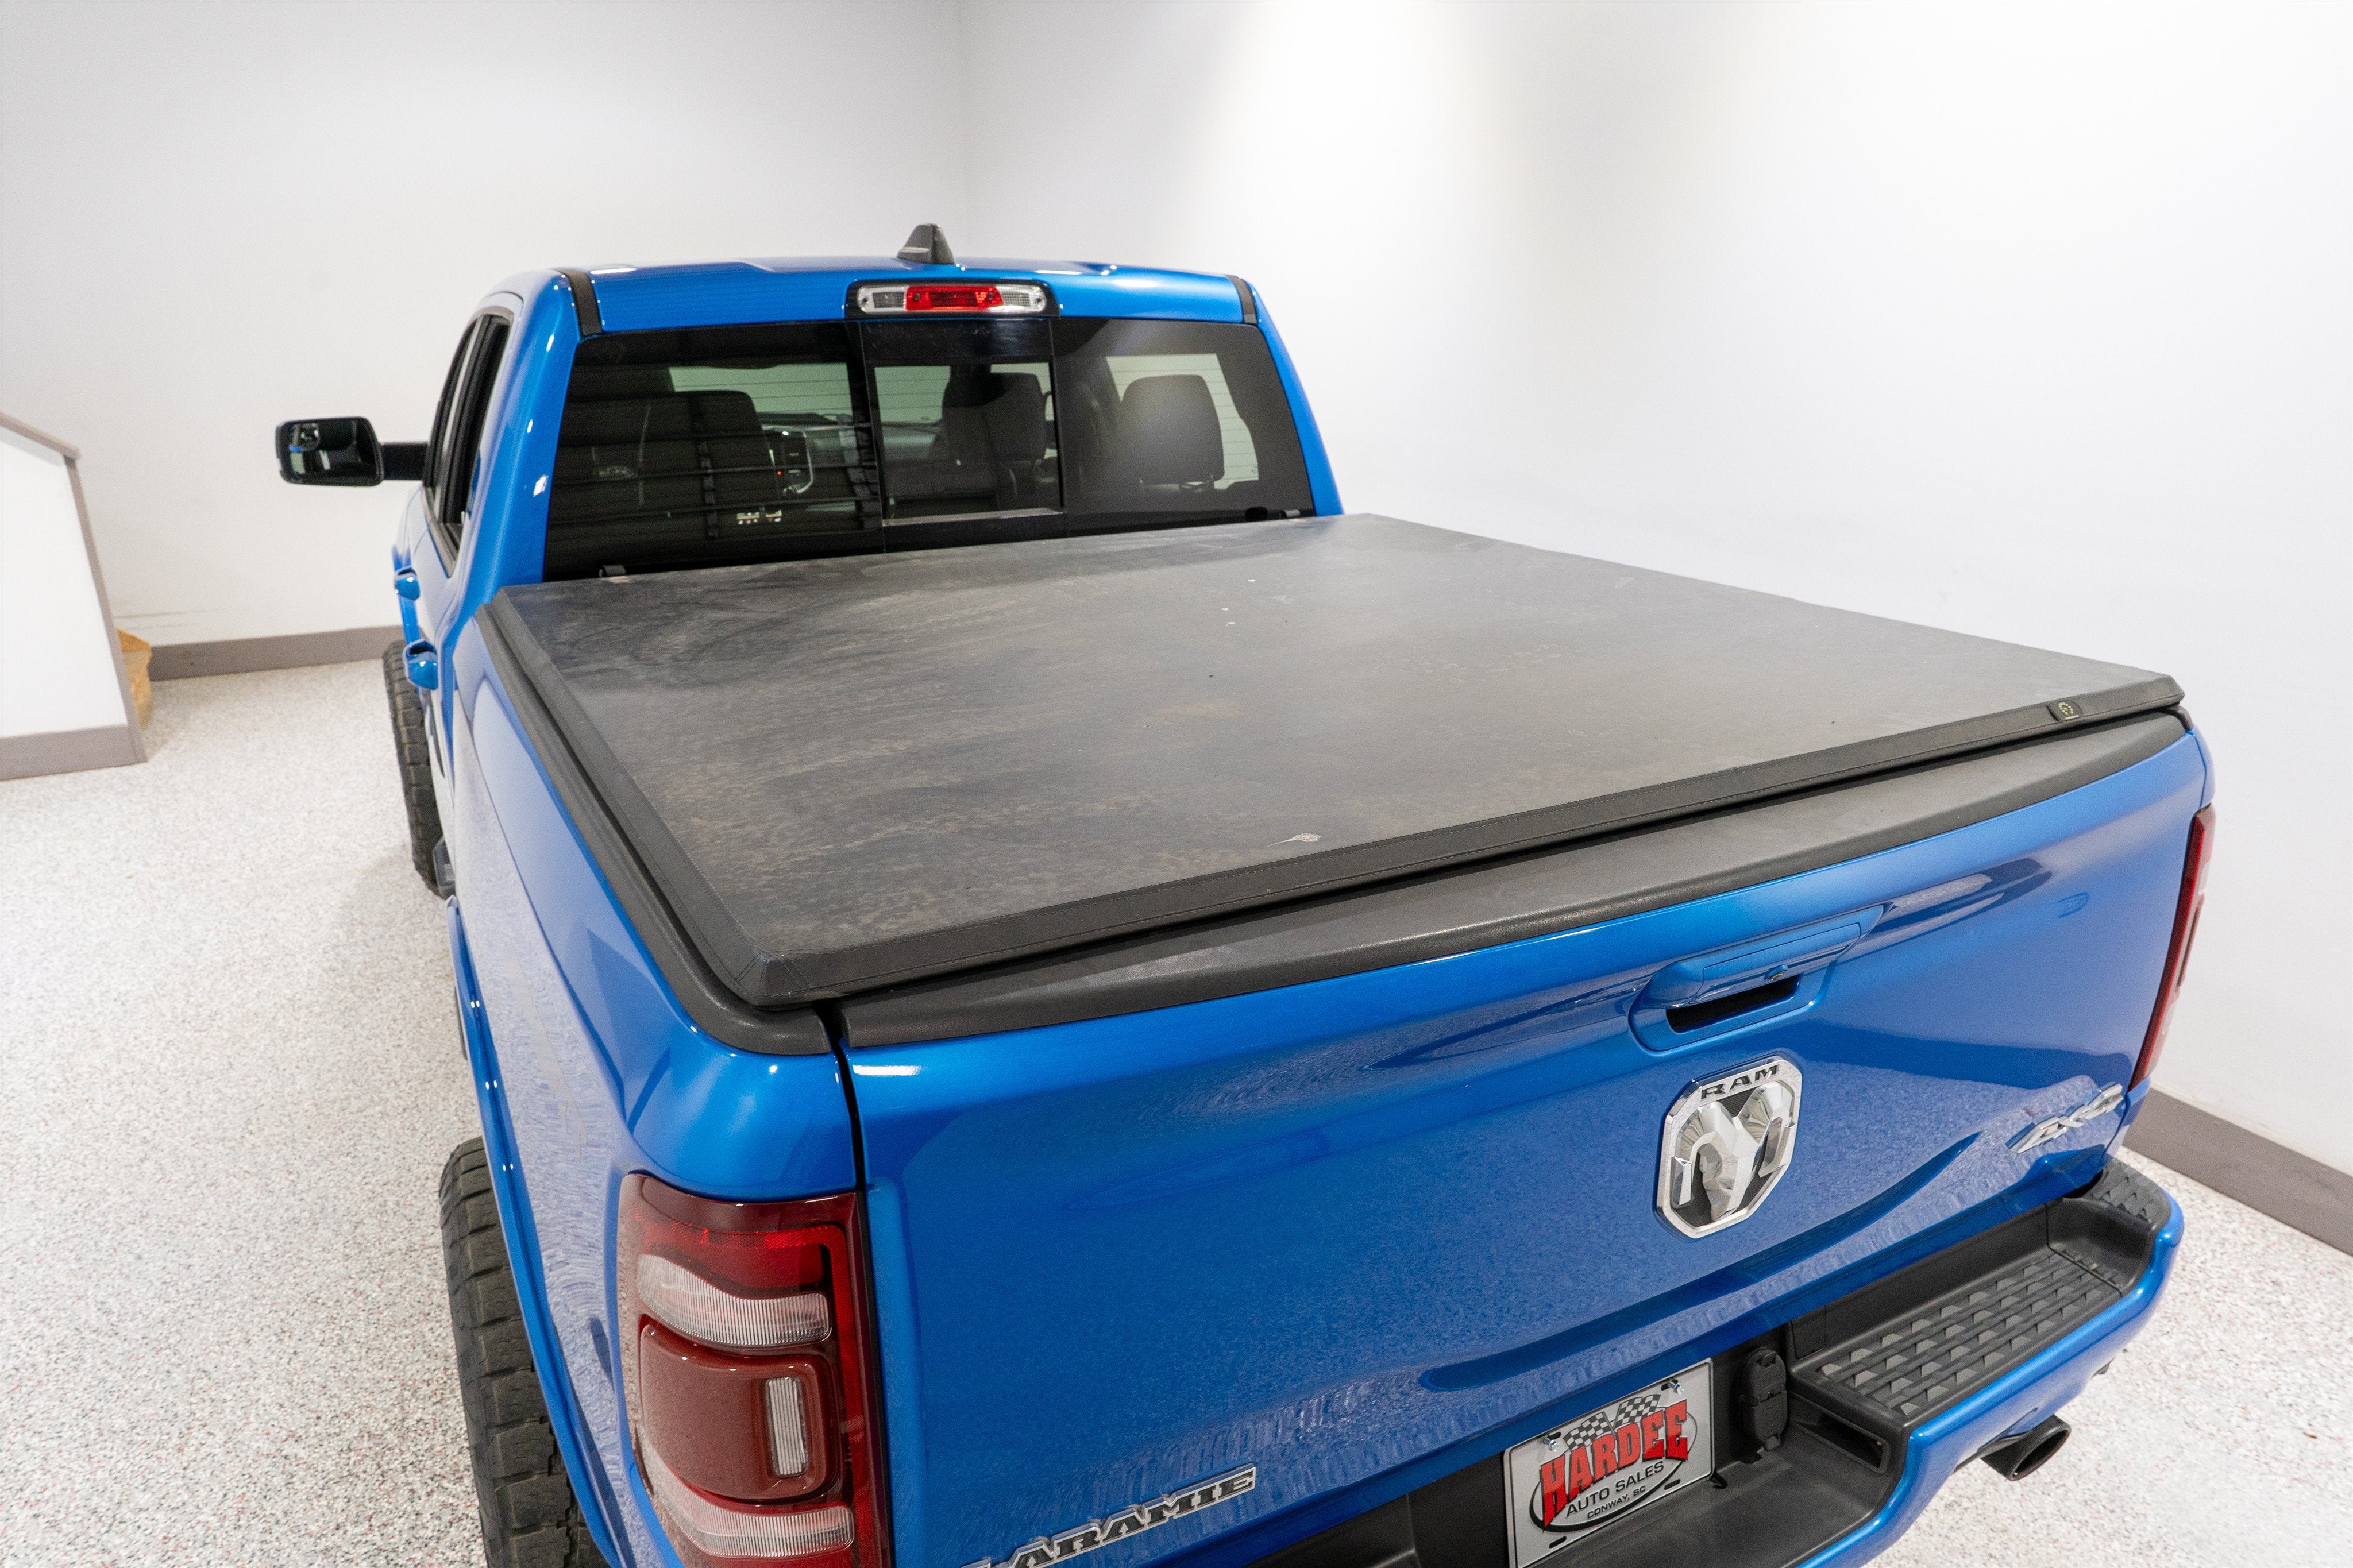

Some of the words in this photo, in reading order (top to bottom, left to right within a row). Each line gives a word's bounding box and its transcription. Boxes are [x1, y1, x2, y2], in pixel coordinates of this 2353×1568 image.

[1700, 1064, 1779, 1100] RAM
[1540, 1399, 1688, 1530] HARDEE
[1567, 1487, 1610, 1517] AUTO
[1615, 1461, 1664, 1493] SALES
[962, 1467, 1256, 1568] ARAMIE
[1587, 1494, 1630, 1519] CONWAY,
[1633, 1485, 1646, 1497] SC
